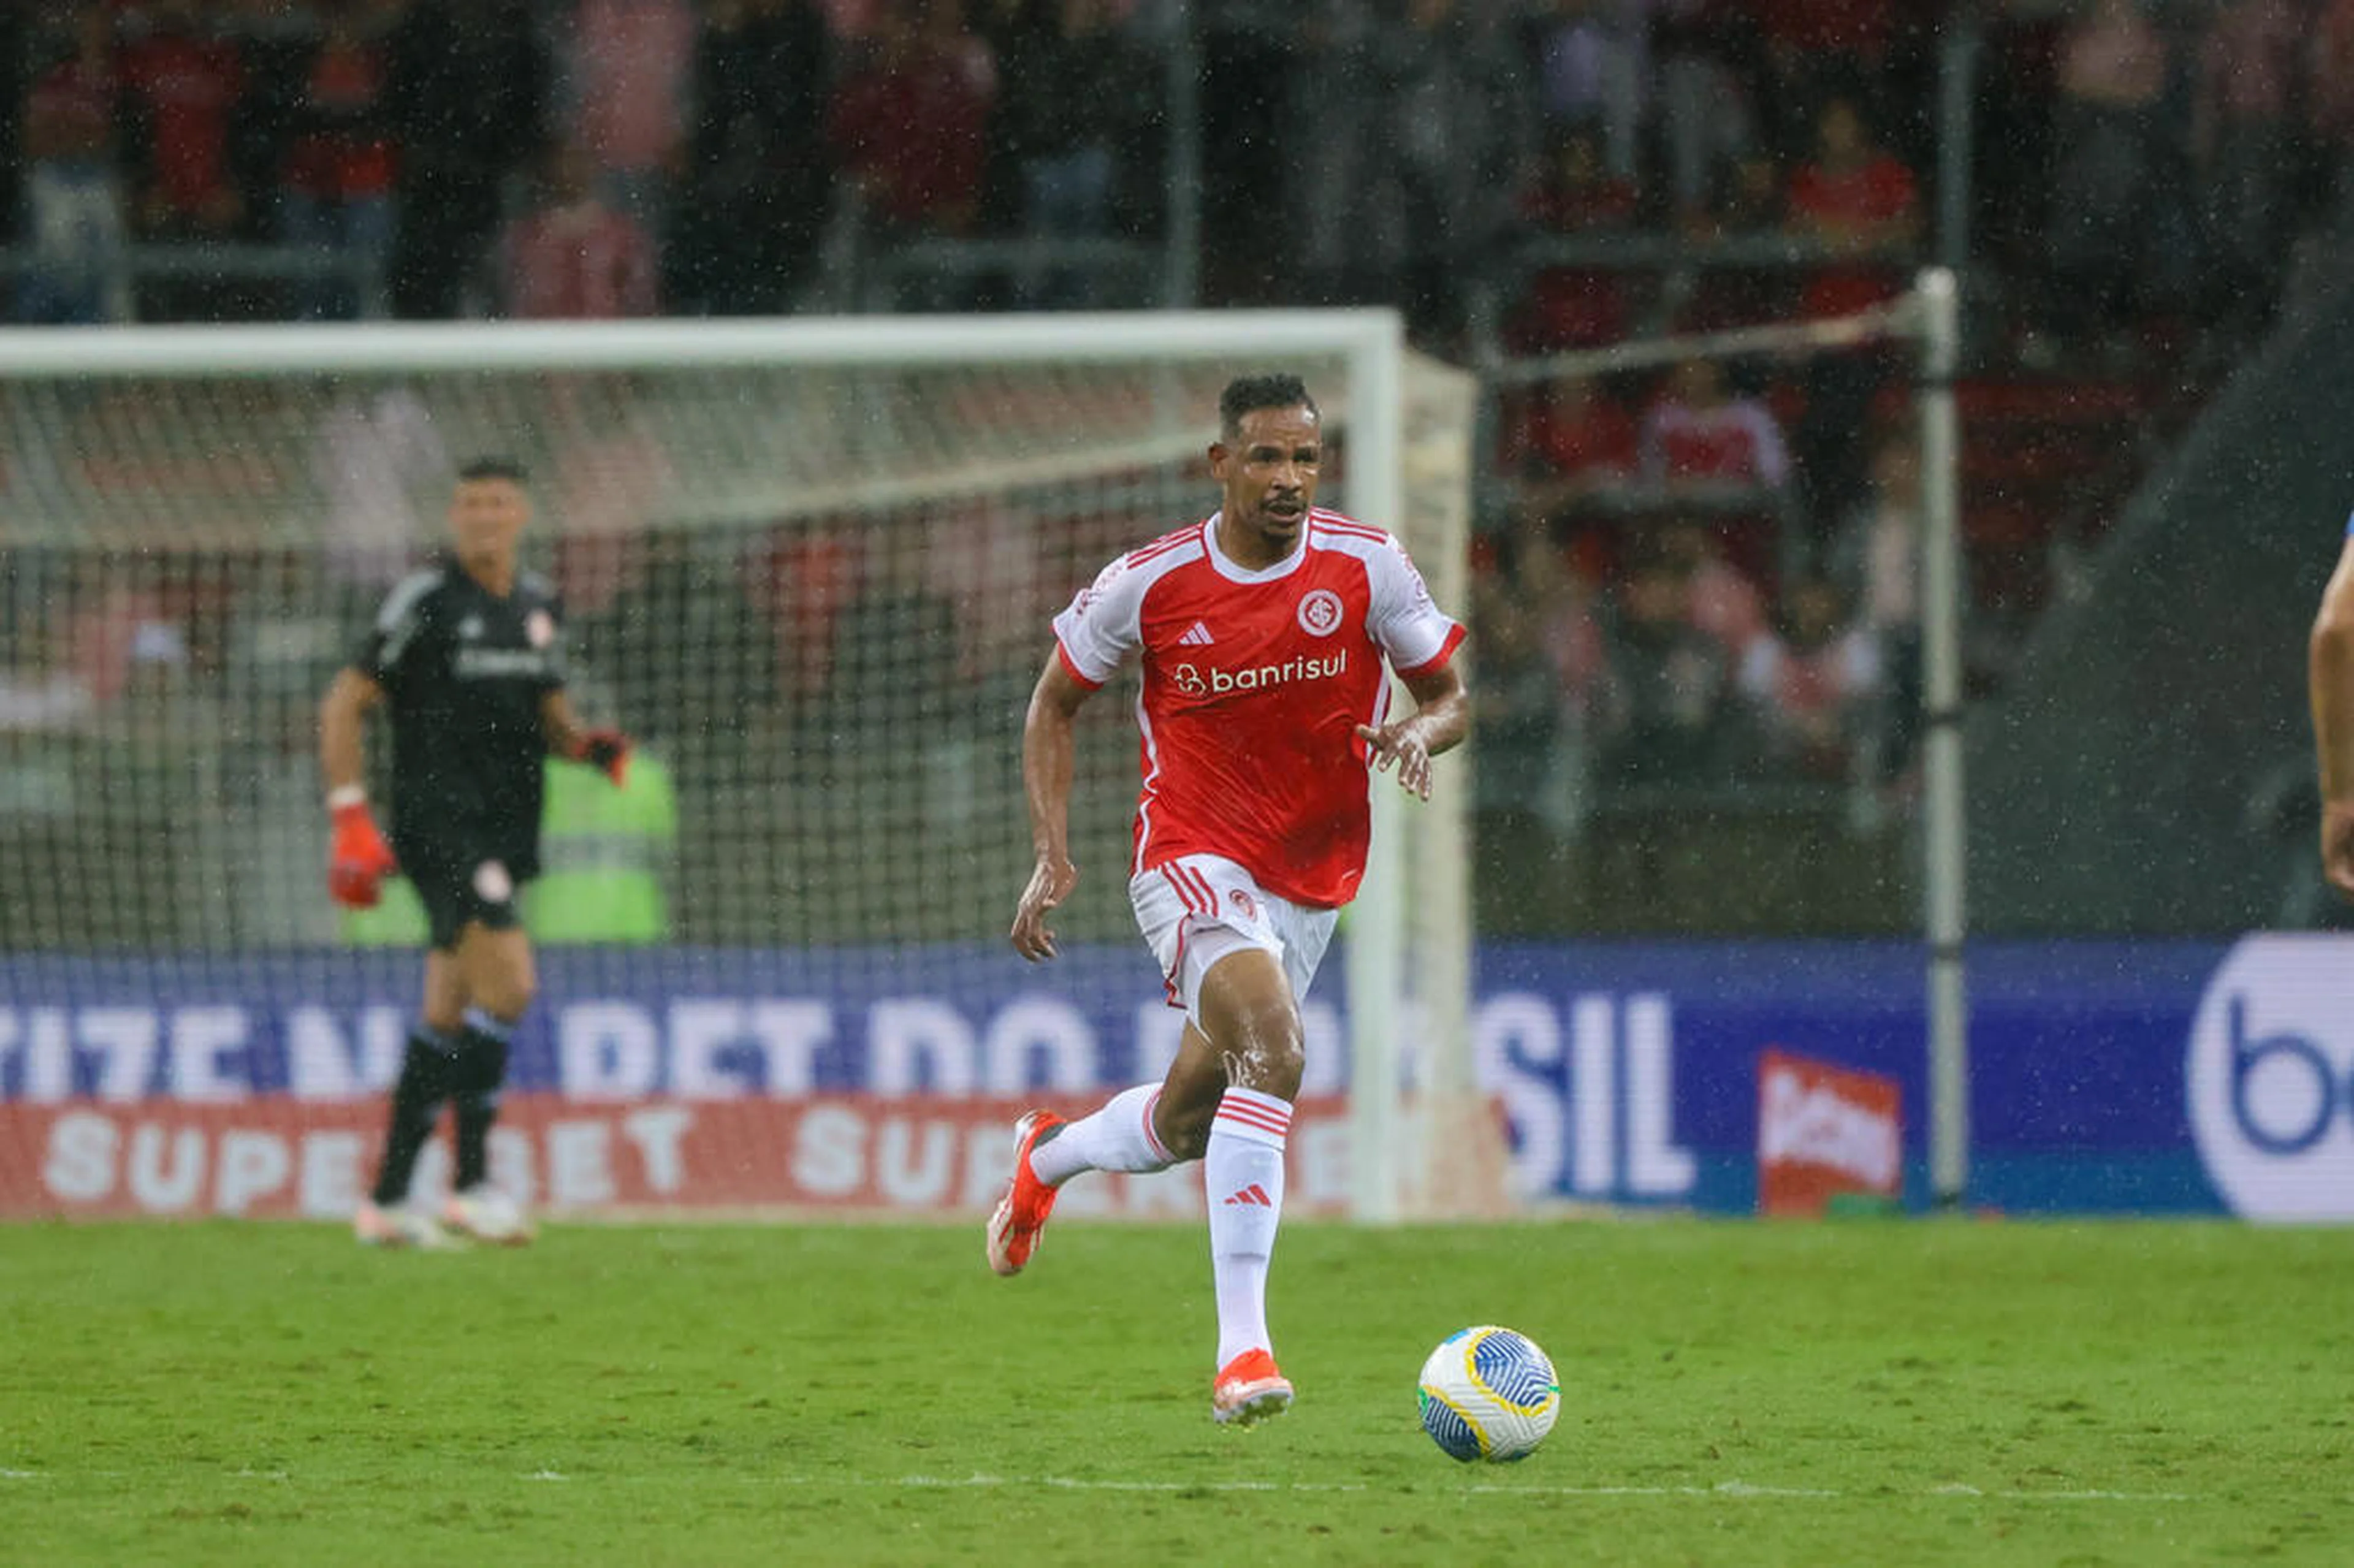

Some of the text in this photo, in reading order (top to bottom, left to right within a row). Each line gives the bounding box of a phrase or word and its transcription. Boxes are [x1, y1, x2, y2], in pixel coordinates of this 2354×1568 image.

[1211, 647, 1347, 693] banrisul
[0, 1004, 253, 1102] IZE
[2226, 990, 2354, 1157] b
